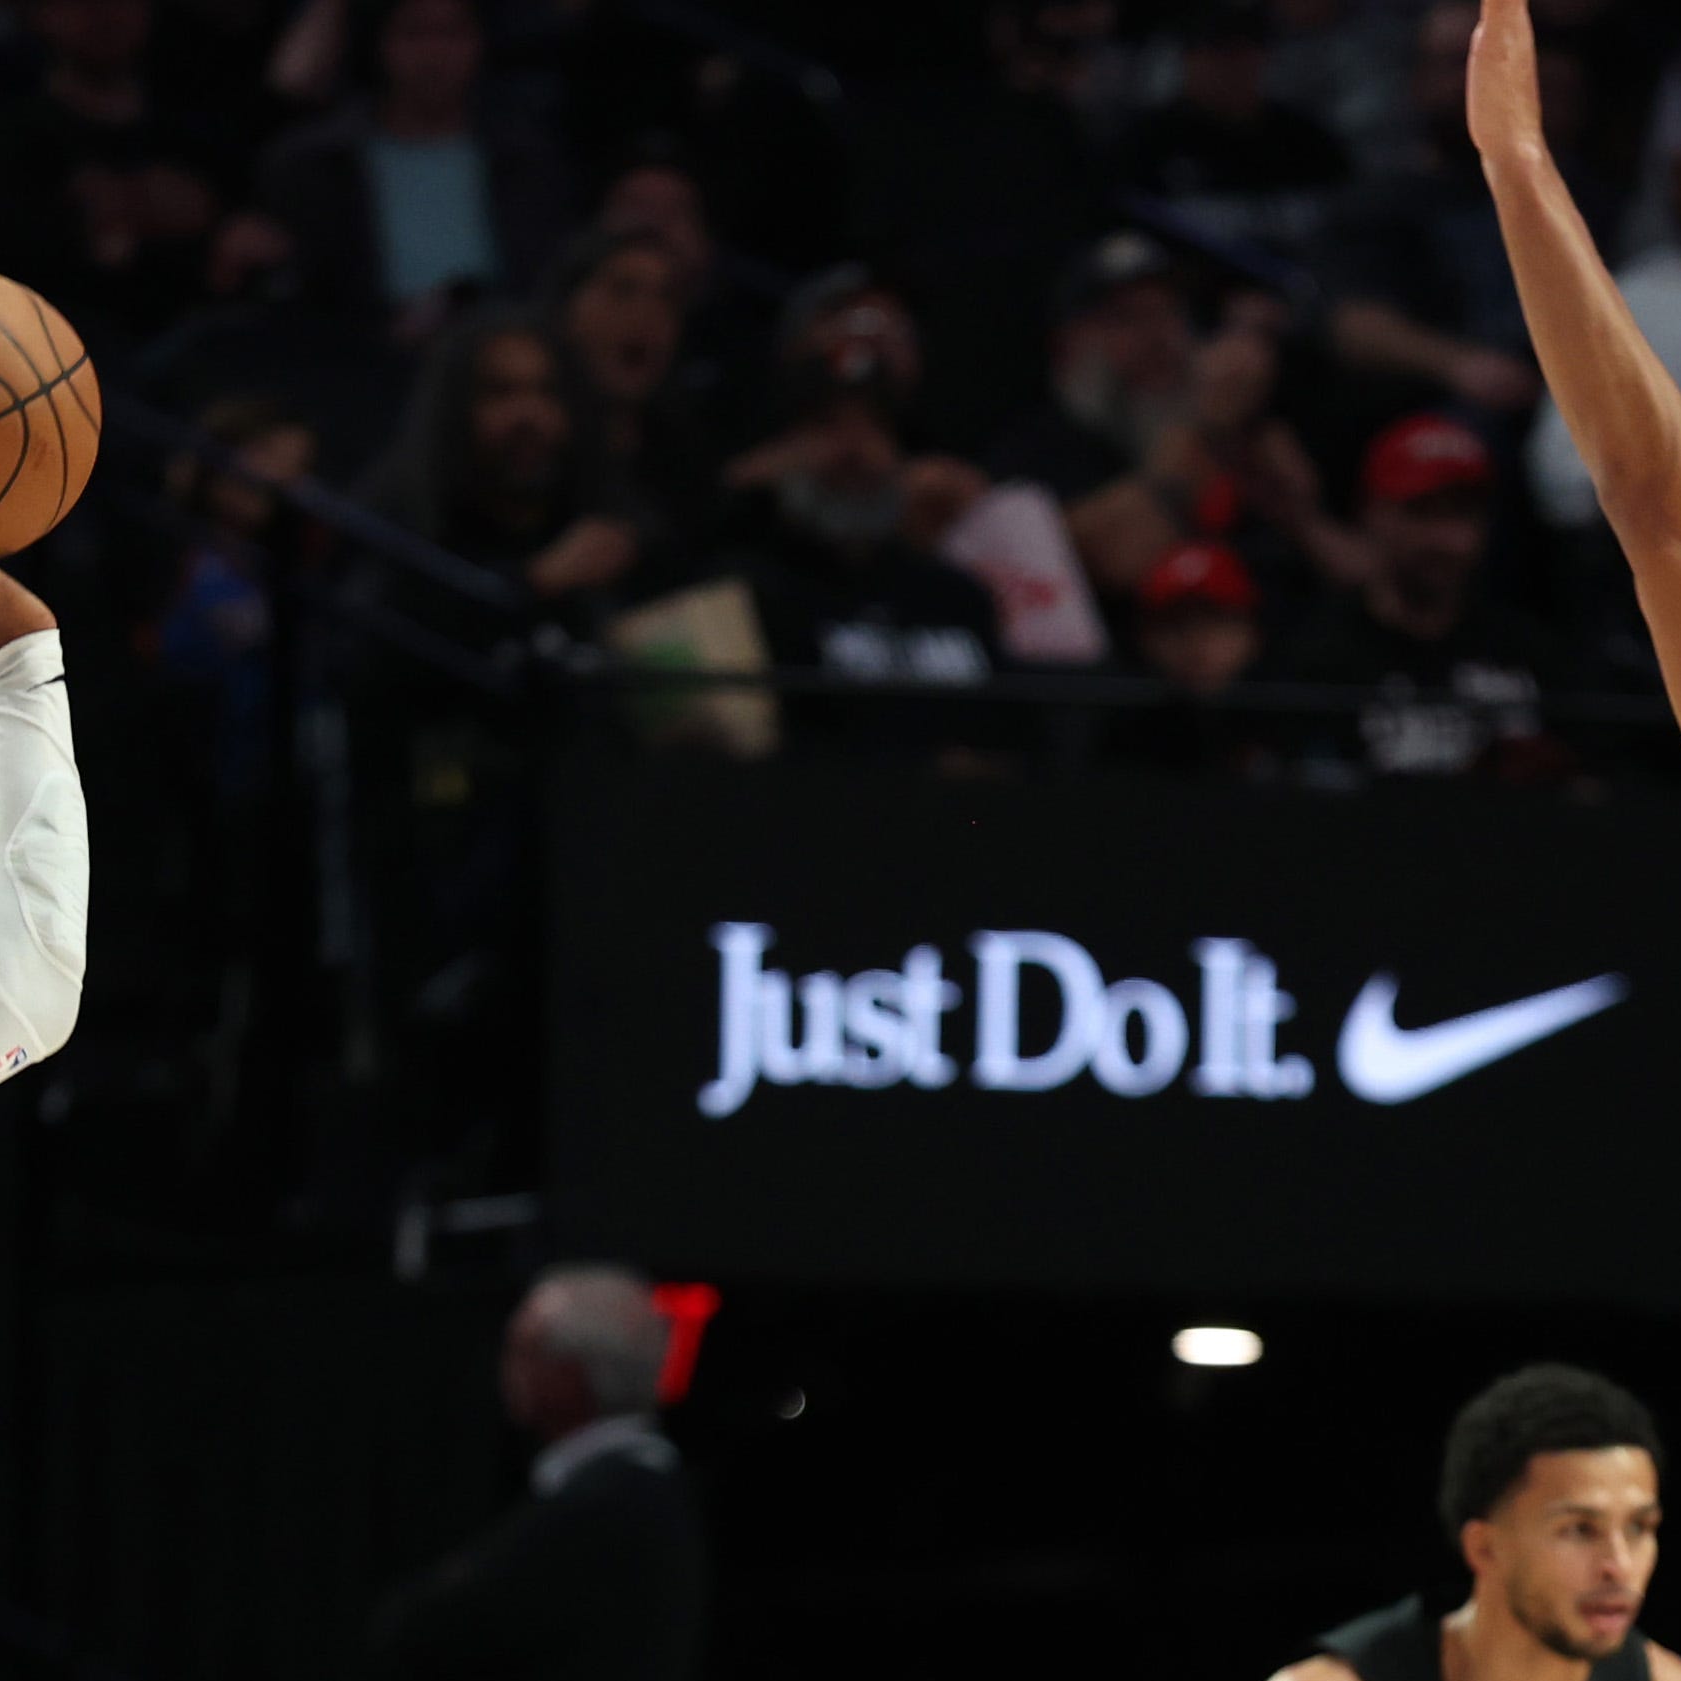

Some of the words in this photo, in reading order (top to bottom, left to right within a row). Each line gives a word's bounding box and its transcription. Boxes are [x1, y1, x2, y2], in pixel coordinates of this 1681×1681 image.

[697, 922, 962, 1119] Just
[967, 928, 1190, 1098] Do
[1189, 936, 1316, 1102] It.
